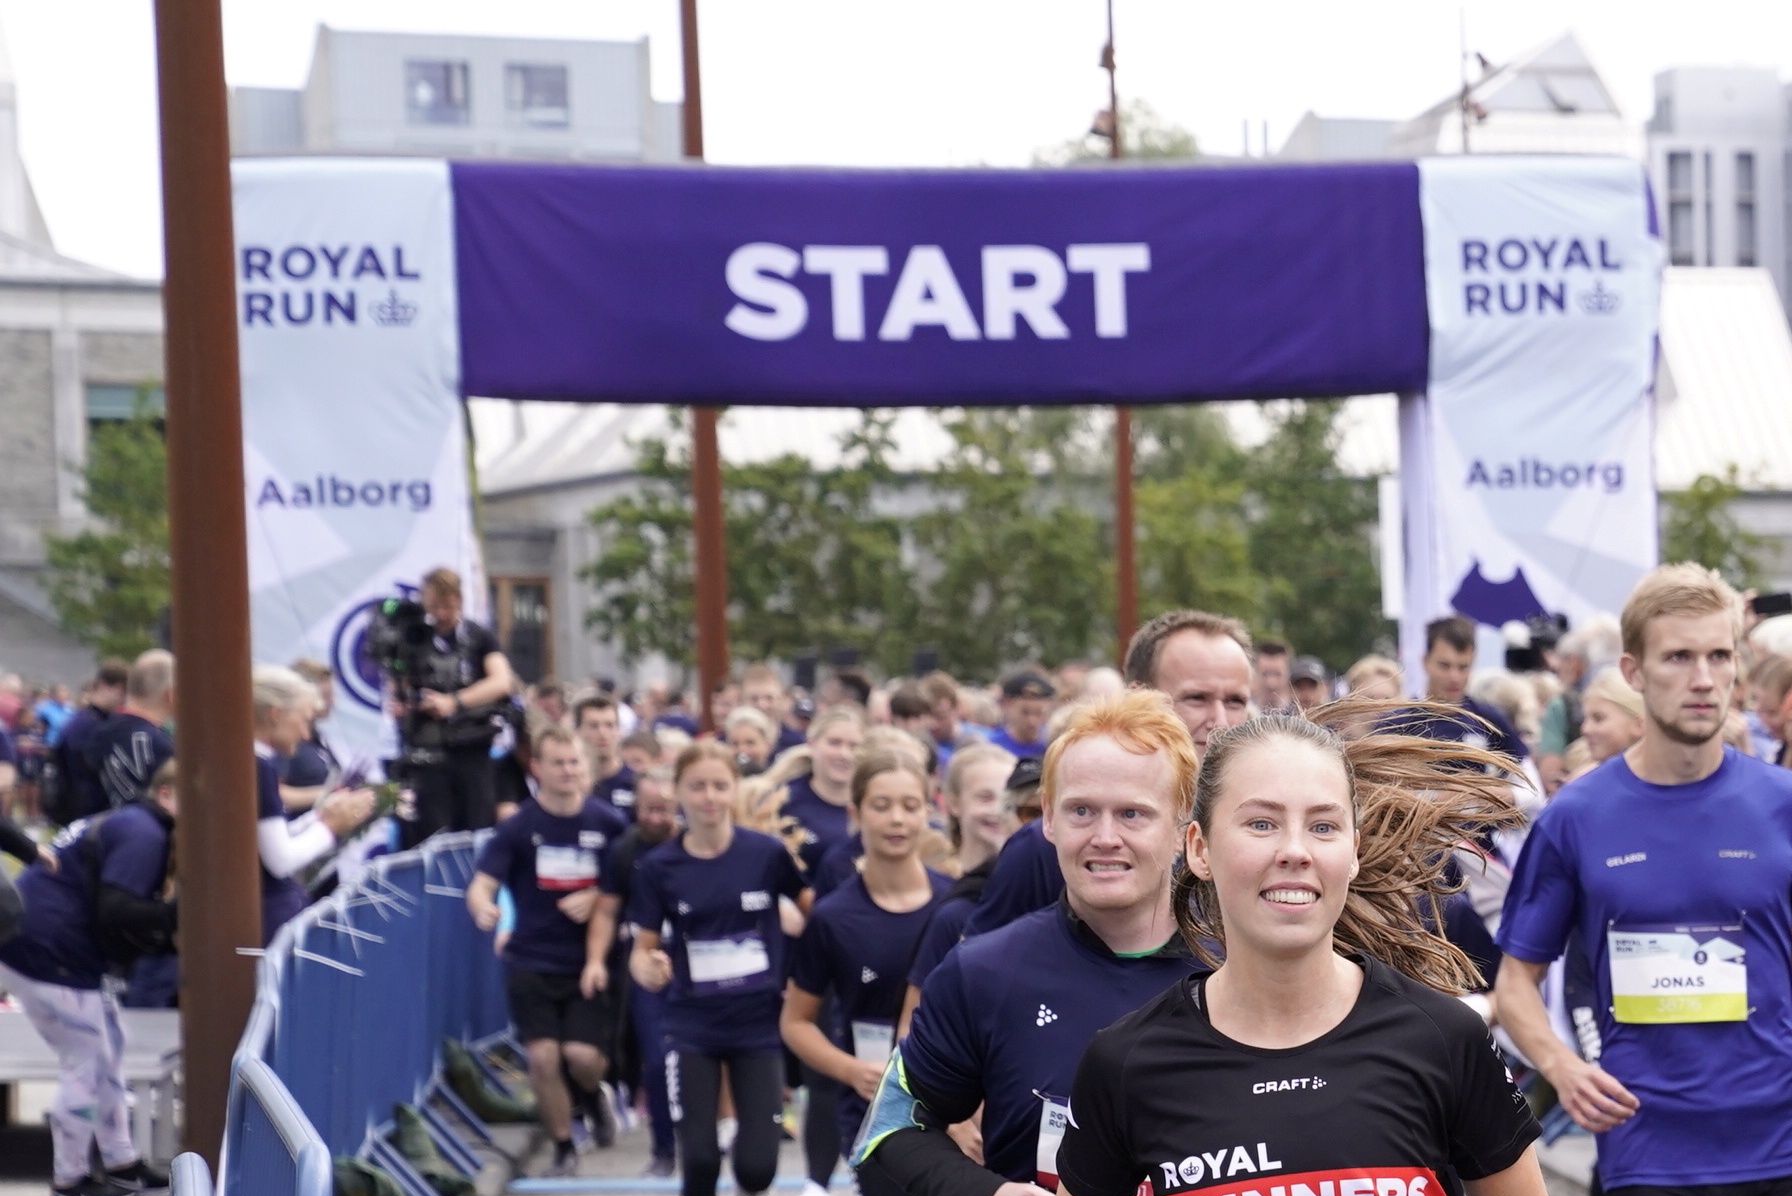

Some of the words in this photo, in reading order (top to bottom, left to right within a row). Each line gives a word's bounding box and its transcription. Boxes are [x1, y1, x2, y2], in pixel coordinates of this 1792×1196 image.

[241, 244, 421, 282] ROYAL
[1461, 237, 1621, 272] ROYAL
[243, 290, 356, 327] RUN
[723, 241, 1151, 341] START
[1464, 281, 1565, 316] RUN
[257, 474, 432, 512] Aalborg
[1466, 458, 1623, 493] Aalborg
[1651, 976, 1705, 989] JONAS
[1252, 1078, 1310, 1094] CRAFT
[1159, 1142, 1282, 1189] ROYAL
